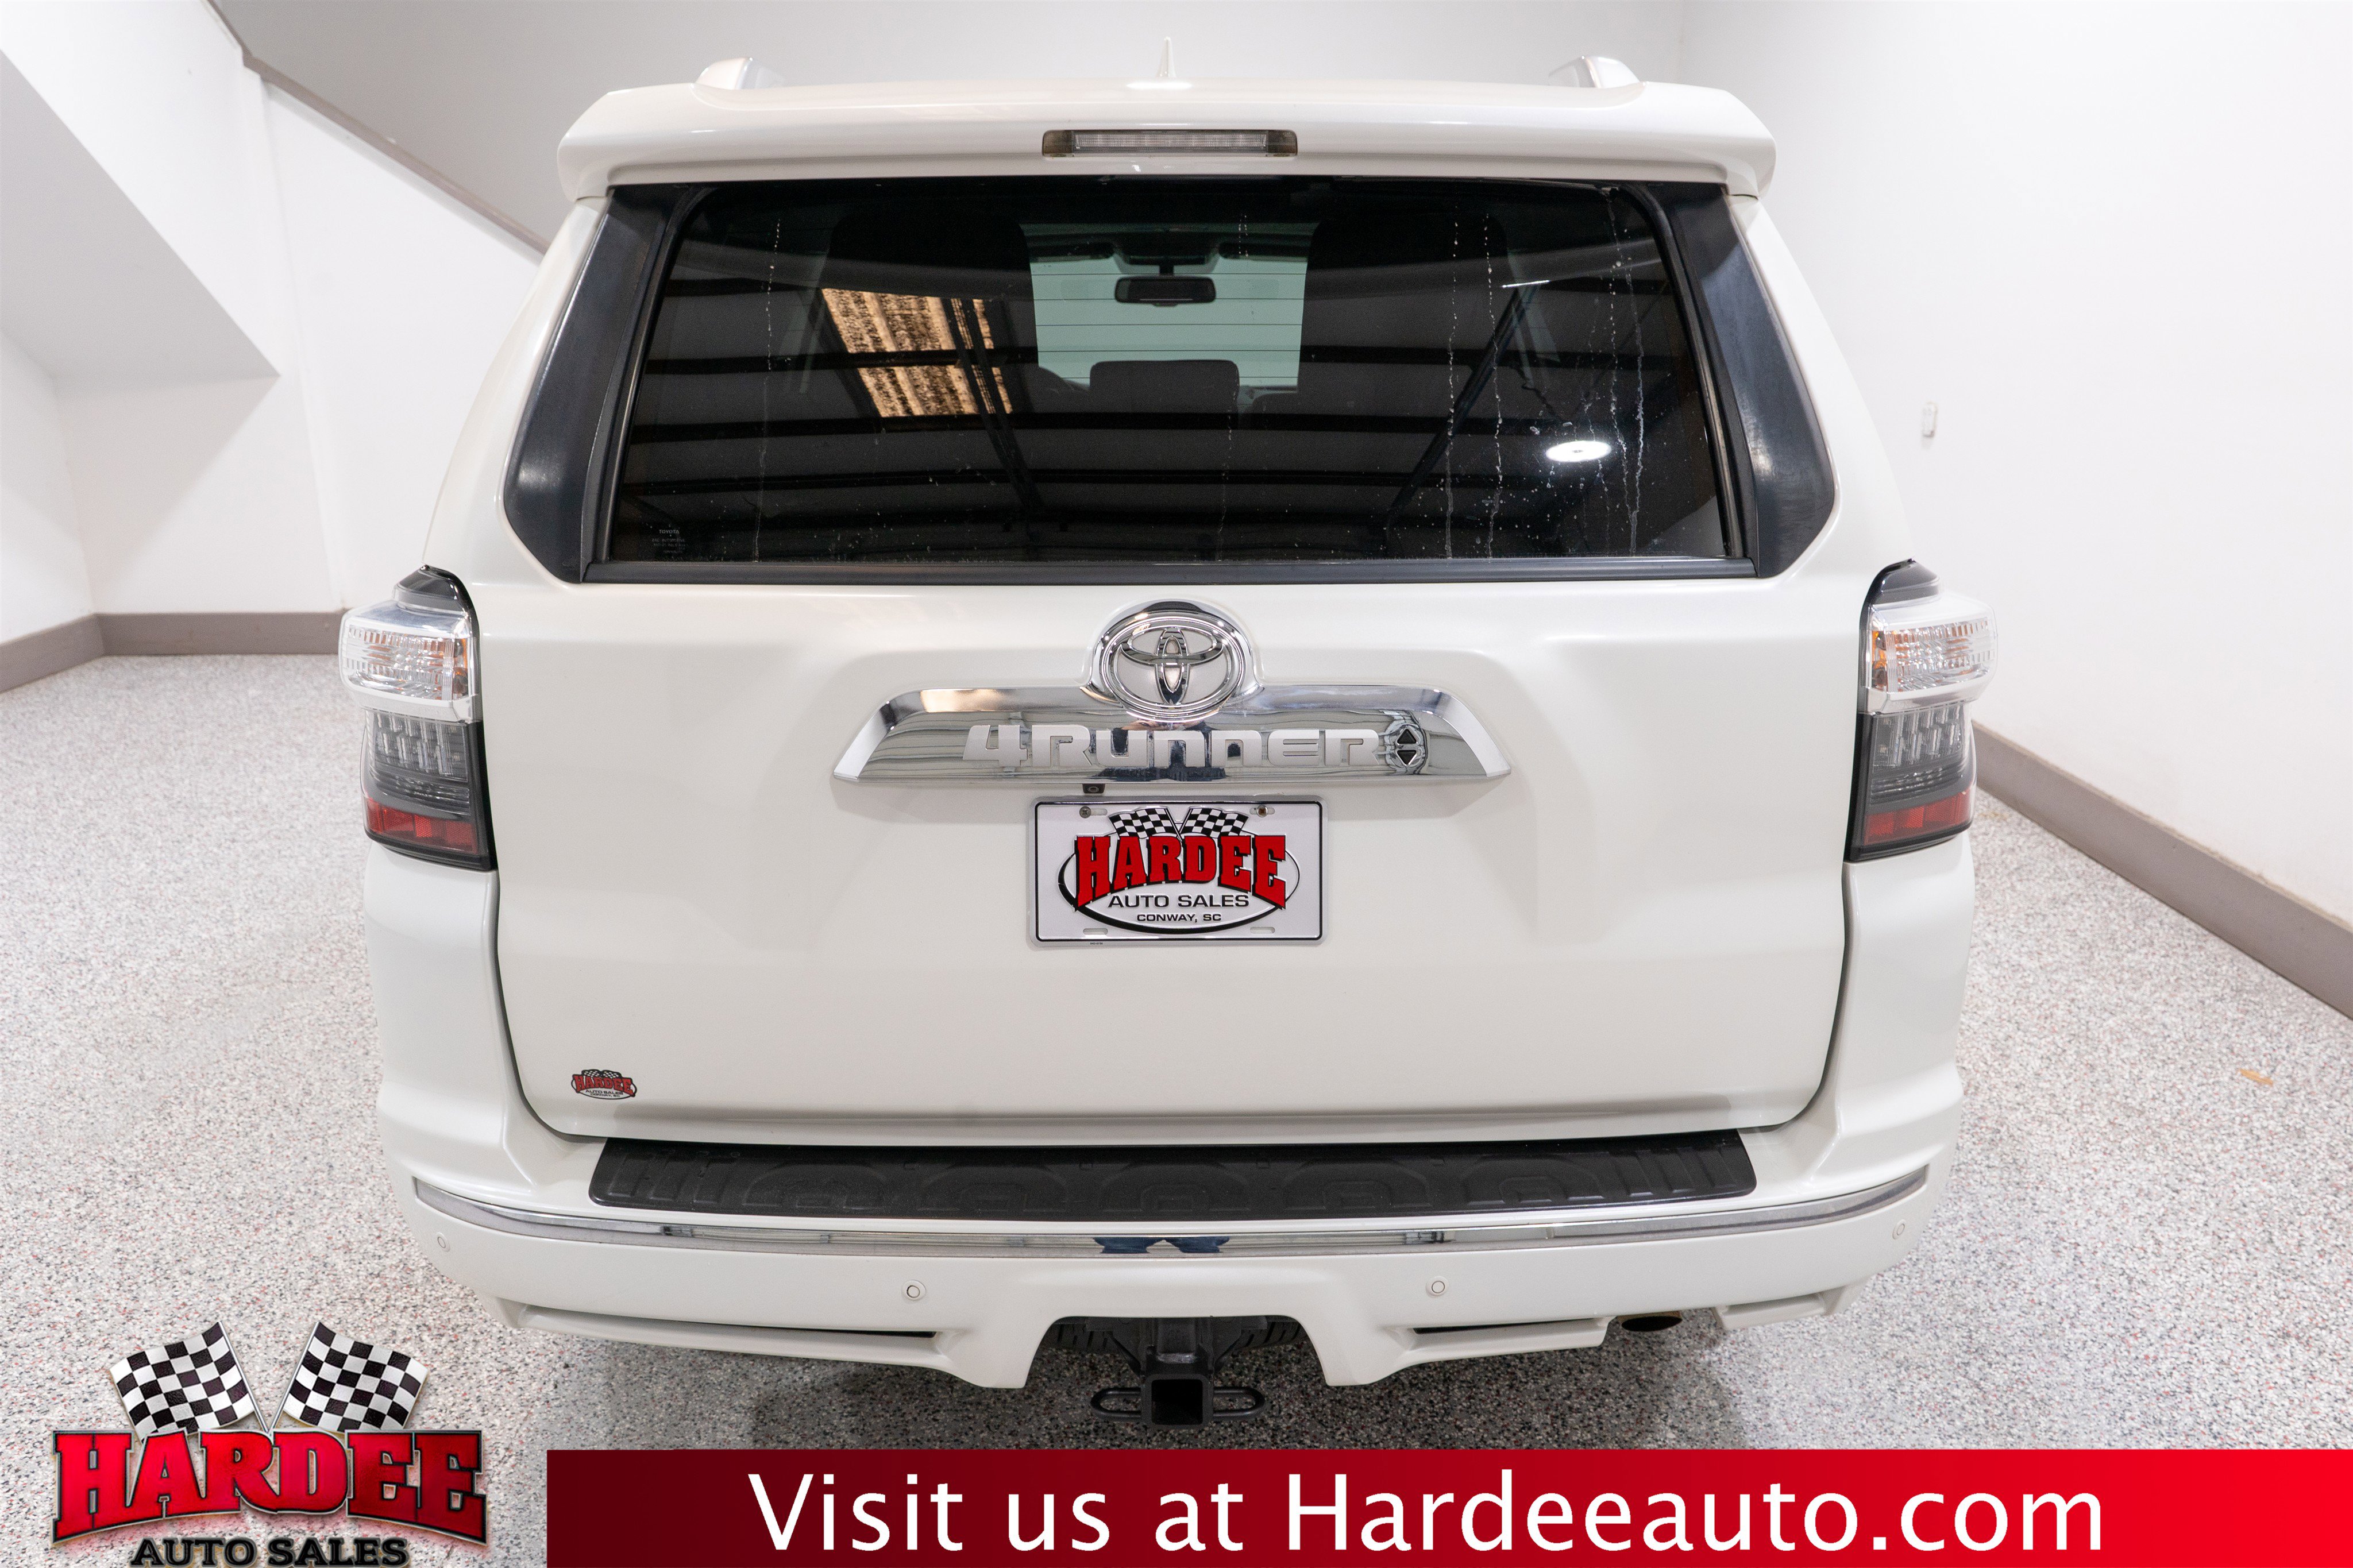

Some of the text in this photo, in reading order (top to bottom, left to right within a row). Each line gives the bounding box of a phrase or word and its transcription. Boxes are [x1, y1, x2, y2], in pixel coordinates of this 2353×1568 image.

[1075, 835, 1286, 910] HARDEE
[1108, 894, 1249, 908] AUTO SALES
[1137, 913, 1222, 923] CONWAY, SC
[573, 1075, 635, 1096] HARDEE
